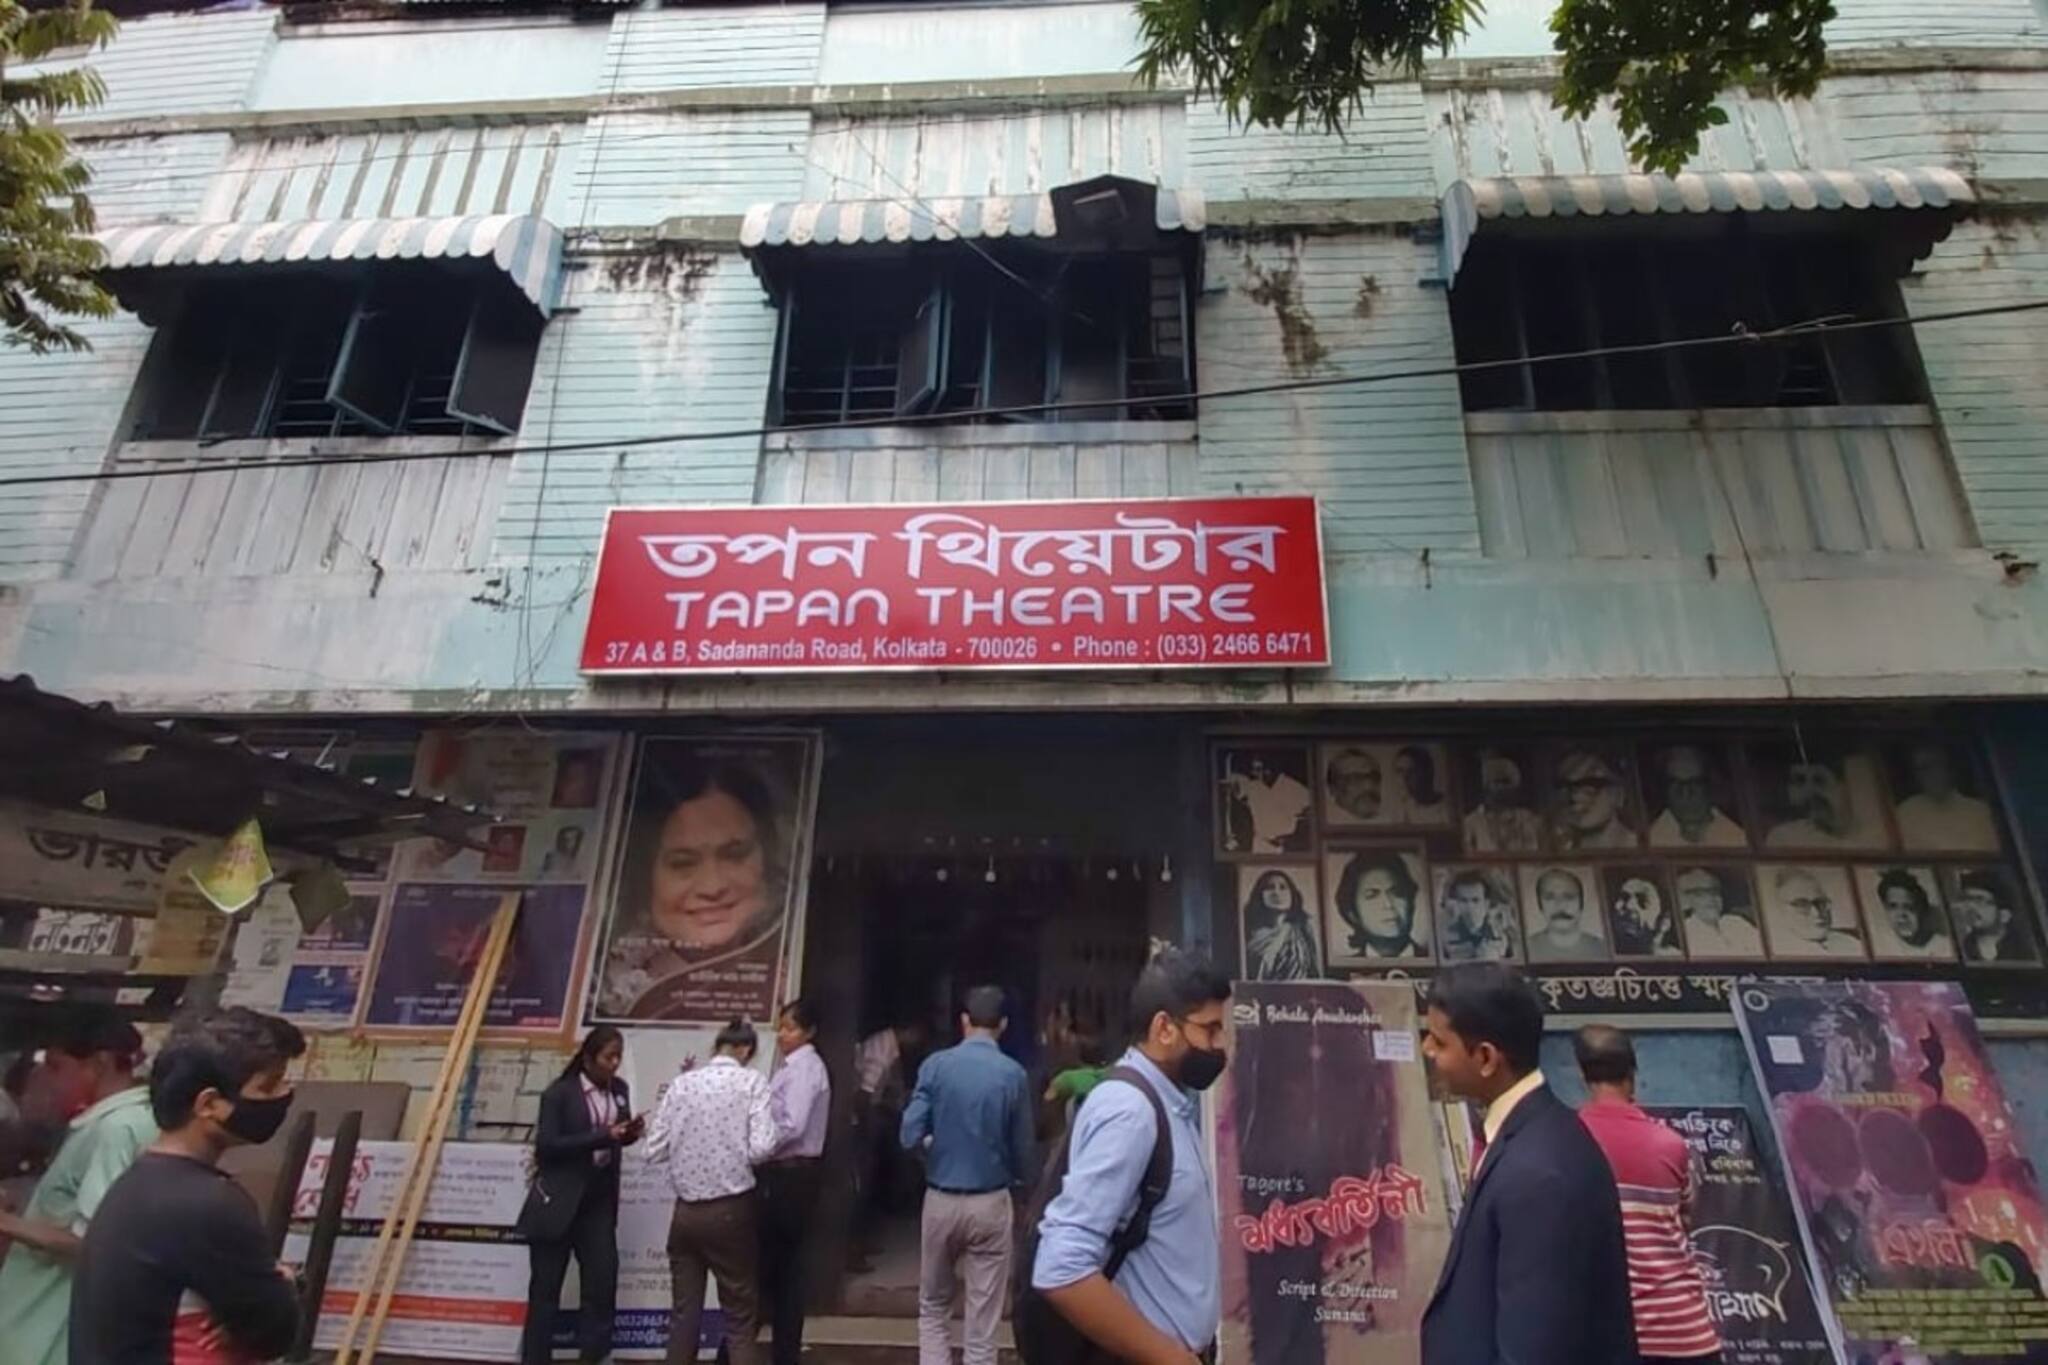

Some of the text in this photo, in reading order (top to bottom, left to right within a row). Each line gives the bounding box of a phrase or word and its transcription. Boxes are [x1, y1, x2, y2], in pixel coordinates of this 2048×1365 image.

[637, 511, 1288, 581] তপন থিয়েটার
[665, 583, 1256, 630] TAPAN THEATRE
[606, 641, 629, 663] 37
[631, 641, 648, 662] A
[652, 641, 667, 662] &
[698, 638, 805, 662] Sadananda
[810, 637, 867, 662] Road,
[873, 636, 947, 659] Kolkata
[968, 636, 1037, 659] 700026
[1073, 635, 1138, 658] Phone
[1157, 633, 1207, 661] (033)
[1212, 633, 1260, 656] 2466
[1265, 632, 1312, 655] 6471
[1236, 1175, 1305, 1195] Tagore's
[1278, 1280, 1316, 1301] Script
